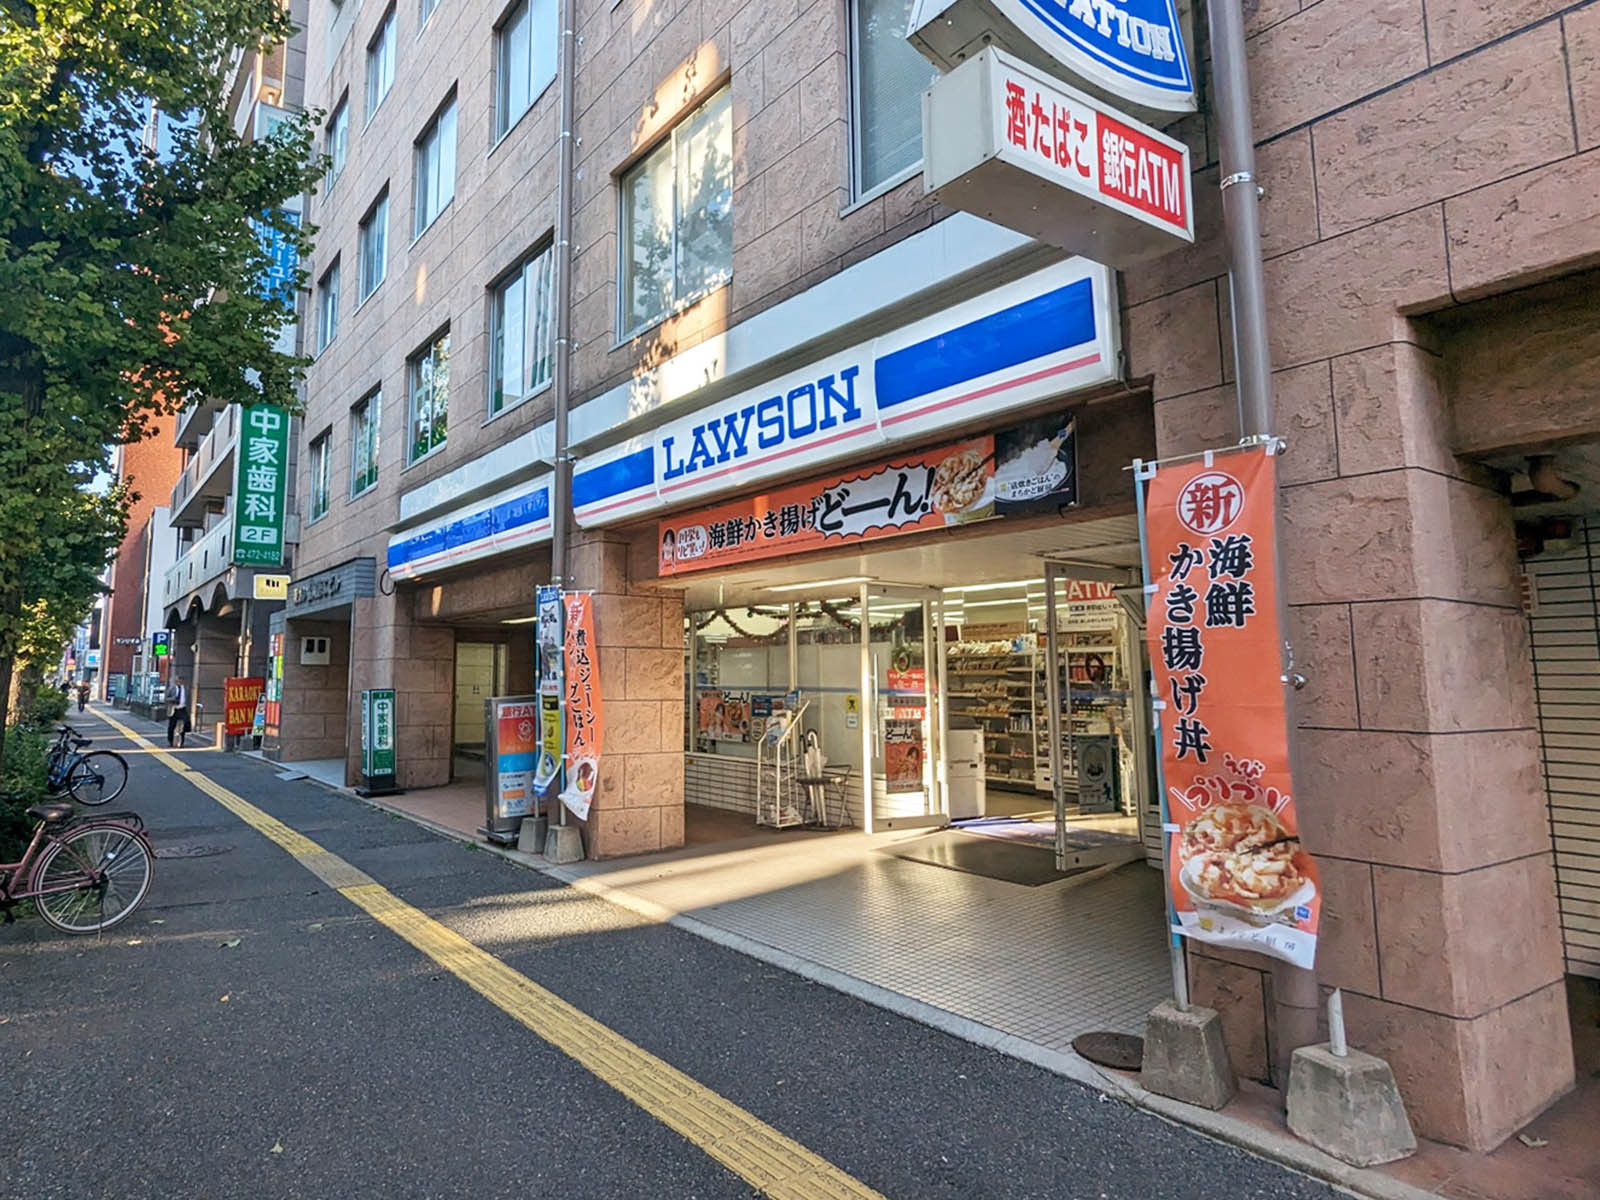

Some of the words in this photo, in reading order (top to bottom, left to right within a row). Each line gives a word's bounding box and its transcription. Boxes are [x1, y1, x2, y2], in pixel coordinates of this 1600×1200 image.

[1053, 0, 1175, 62] ATION
[1102, 128, 1181, 217] 銀行ATM
[661, 365, 862, 480] LAWSON
[244, 407, 281, 523] 中家歯科
[1187, 482, 1237, 529] 新
[246, 528, 272, 540] 2F
[1068, 580, 1114, 599] ATM
[1204, 536, 1255, 628] 海鮮
[157, 633, 167, 643] P
[1162, 544, 1212, 763] かき揚げ丼
[502, 704, 536, 716] 銀行AT
[1225, 753, 1263, 778] えび
